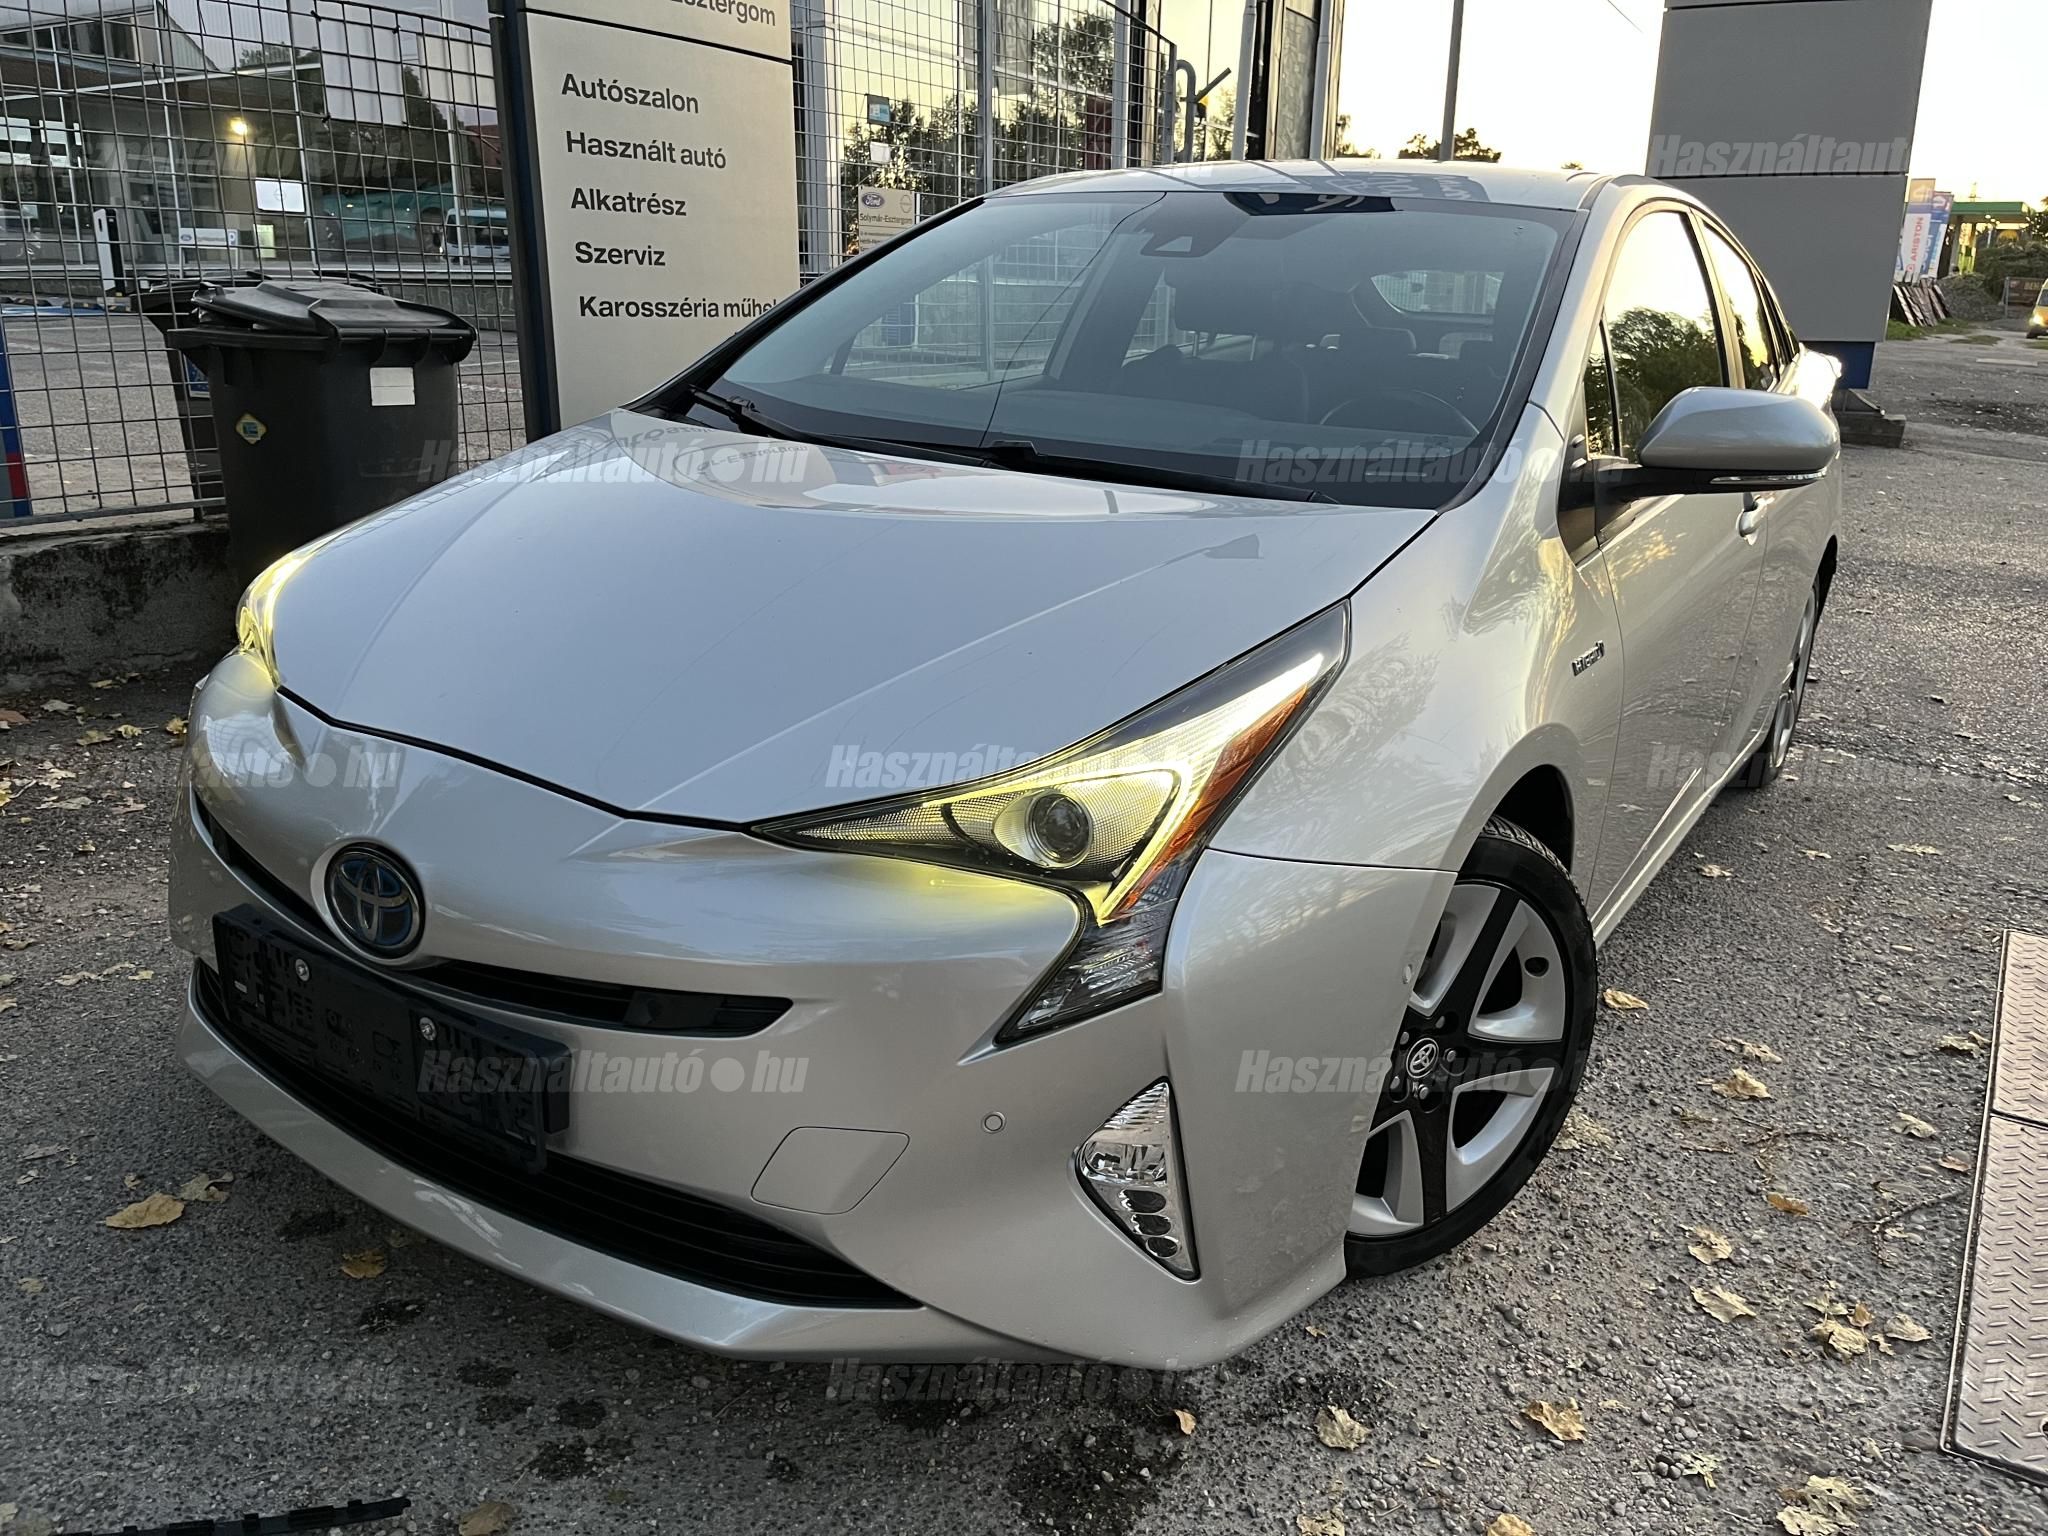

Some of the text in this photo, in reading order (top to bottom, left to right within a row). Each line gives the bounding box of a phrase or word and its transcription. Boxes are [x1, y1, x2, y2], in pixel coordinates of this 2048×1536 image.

[561, 73, 699, 114] Autószalon
[566, 130, 727, 169] Használt autó
[570, 187, 687, 216] Alkatrész
[575, 241, 666, 266] Szerviz
[1911, 216, 1924, 262] ARISTON
[579, 295, 719, 317] Karosszéria
